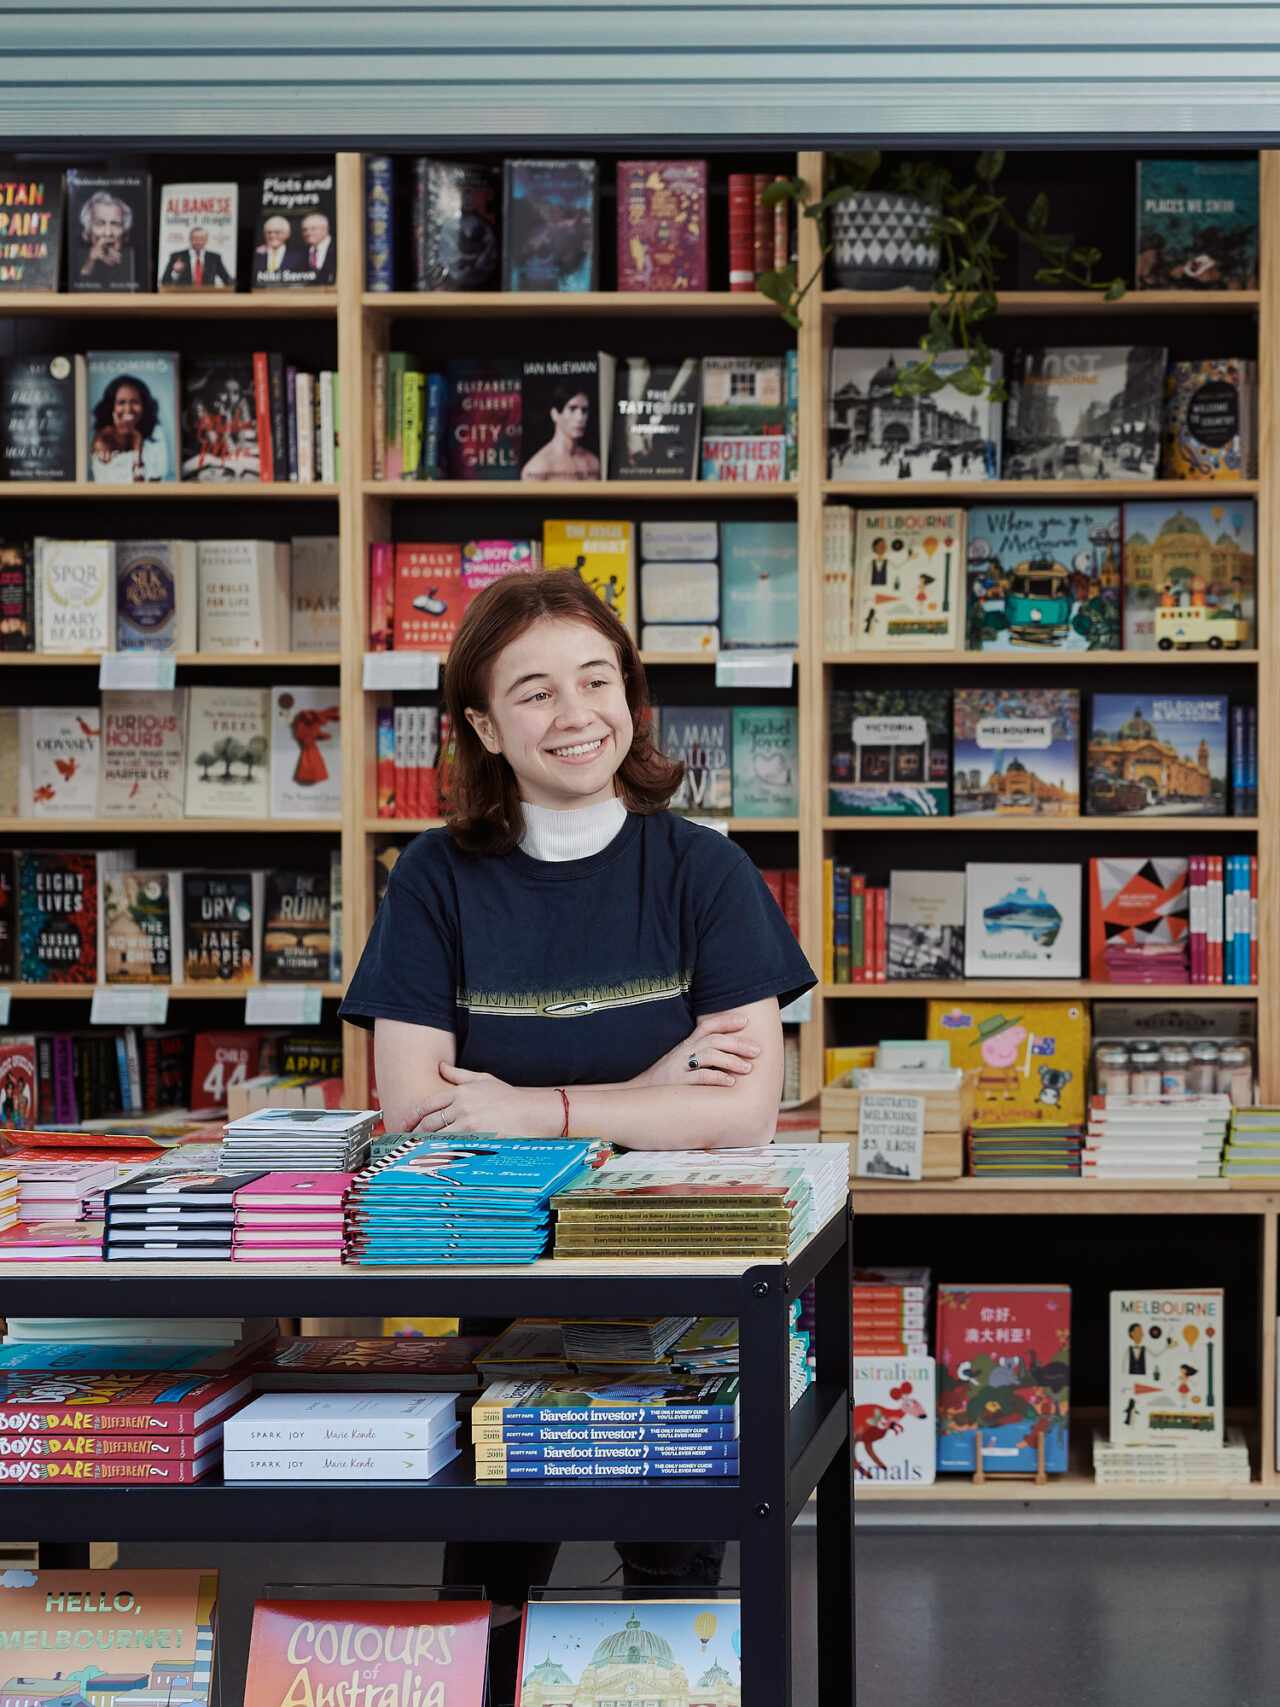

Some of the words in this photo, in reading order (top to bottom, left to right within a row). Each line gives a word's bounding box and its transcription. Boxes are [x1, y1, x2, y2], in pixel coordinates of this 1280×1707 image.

[263, 177, 301, 191] Plots
[303, 175, 333, 191] and
[166, 194, 232, 214] ALBANESE
[262, 192, 320, 208] Prayers
[1146, 199, 1184, 214] PLACES
[524, 362, 545, 375] IAN
[1024, 355, 1101, 375] LOST
[457, 380, 522, 394] ELIZABETH
[462, 398, 515, 411] GILBERT
[454, 424, 501, 443] CITY
[462, 448, 519, 467] GIRLS
[704, 440, 780, 461] MOTHER
[720, 463, 736, 480] IN
[743, 463, 781, 480] LAW
[866, 515, 956, 530] MELBOURNE
[987, 510, 1034, 533] When
[411, 553, 454, 564] SALLY
[53, 565, 98, 585] SPQR
[401, 567, 460, 577] ROONEY
[53, 614, 97, 626] MARY
[402, 622, 456, 630] NORMAL
[404, 633, 453, 641] PEOPLE
[106, 714, 177, 731] FURIOUS
[740, 718, 792, 734] Rachel
[982, 726, 1045, 736] MELBOURNE
[105, 731, 164, 748] HOURS
[667, 725, 678, 747] A
[684, 725, 724, 747] MAN
[36, 873, 84, 892] EIGHT
[37, 894, 84, 912] LIVES
[201, 897, 236, 920] DRY
[280, 895, 327, 920] RUIN
[40, 933, 78, 946] SUSAN
[200, 929, 241, 949] JANE
[38, 947, 81, 960] HURLEY
[188, 948, 252, 967] HARPER
[978, 949, 1039, 961] Australia
[1120, 1300, 1216, 1317] MELBOURNE
[0, 1411, 41, 1433] BOYS
[47, 1411, 95, 1430] DARE
[483, 1413, 500, 1421] 2019
[540, 1410, 590, 1421] barefoot
[591, 1410, 637, 1421] investor
[250, 1431, 282, 1440] SPARK
[288, 1431, 306, 1440] JOY
[323, 1429, 349, 1440] Marie
[540, 1428, 590, 1440] barefoot
[591, 1428, 637, 1440] investor
[48, 1436, 96, 1454] DARE
[47, 1460, 95, 1478] DARE
[250, 1460, 281, 1469] SPARK
[288, 1460, 305, 1469] JOY
[323, 1458, 348, 1469] Marie
[45, 1591, 143, 1617] HELLO,
[0, 1628, 183, 1650] MELBOURNE!
[287, 1622, 456, 1667] COLOURS
[363, 1664, 381, 1681] of
[278, 1667, 446, 1707] Australia
